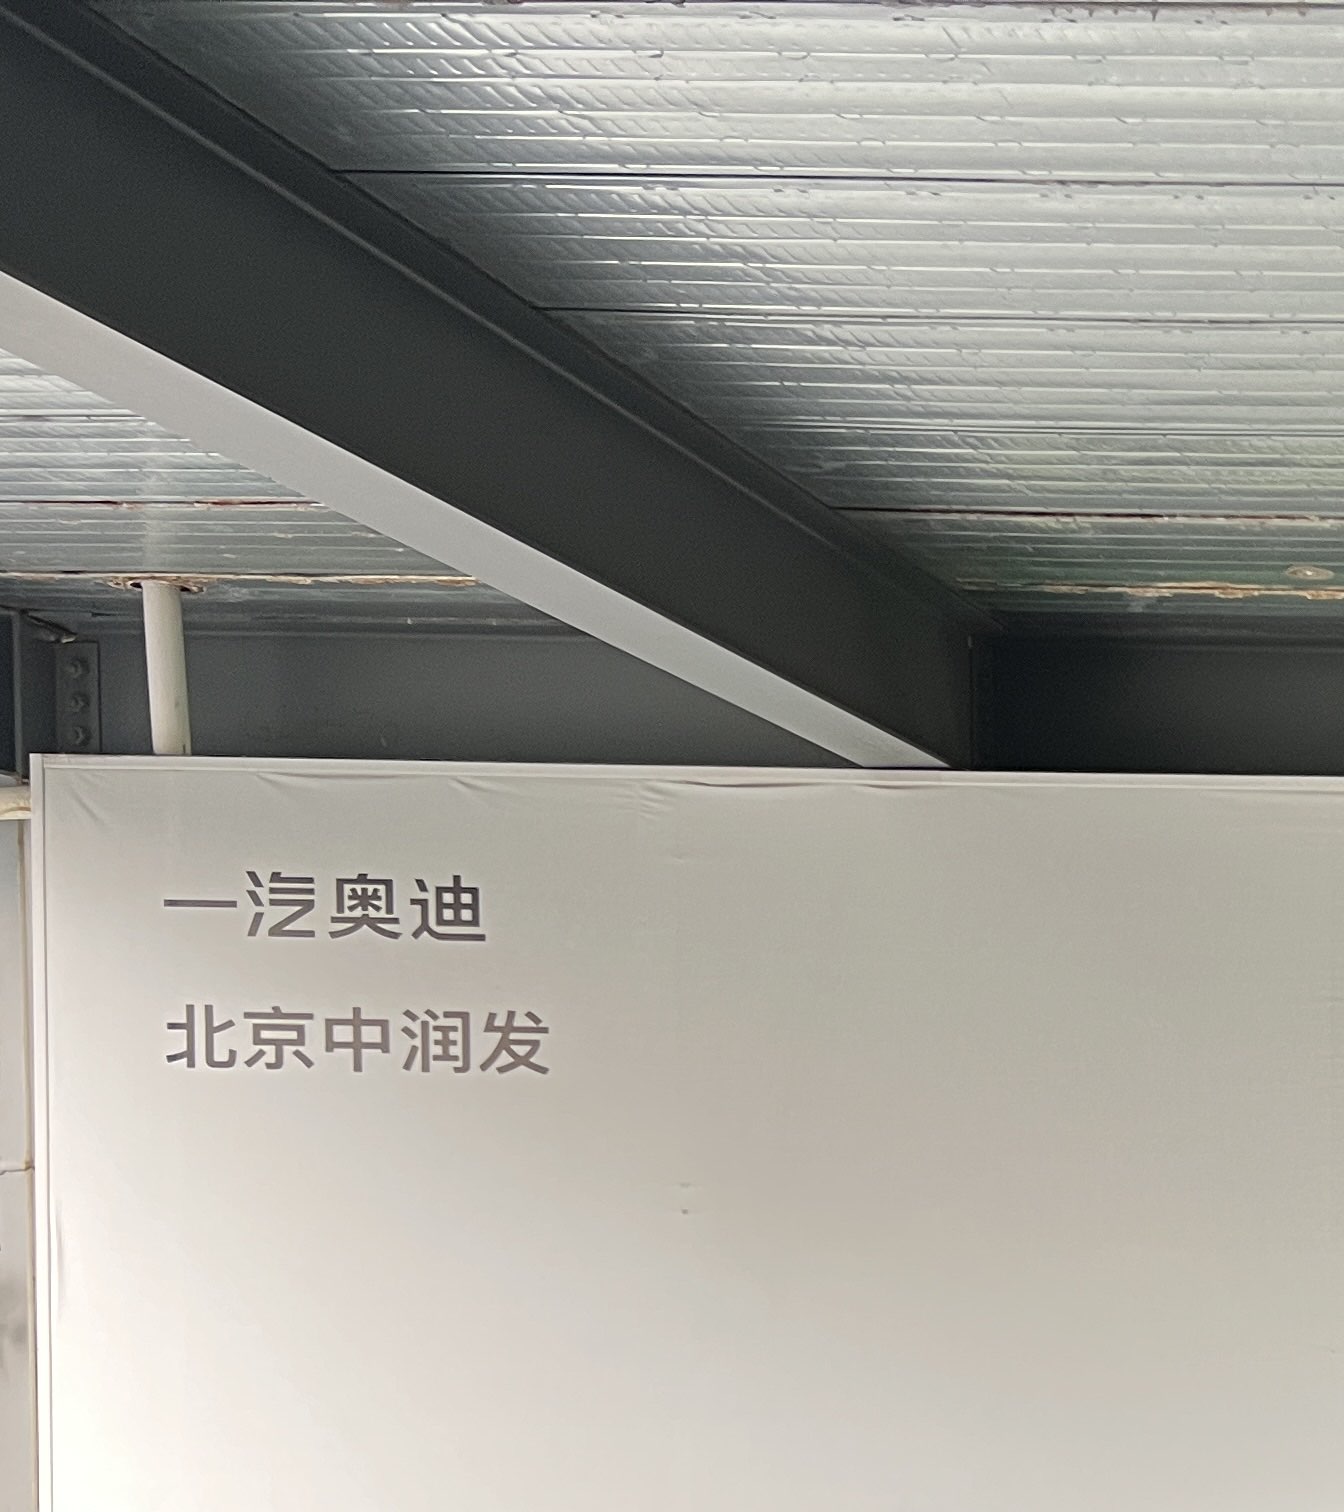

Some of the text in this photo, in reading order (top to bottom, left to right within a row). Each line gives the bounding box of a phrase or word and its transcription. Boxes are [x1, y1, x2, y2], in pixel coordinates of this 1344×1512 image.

[163, 870, 486, 942] 一汽奥迪
[165, 1004, 550, 1075] 北京中润发
